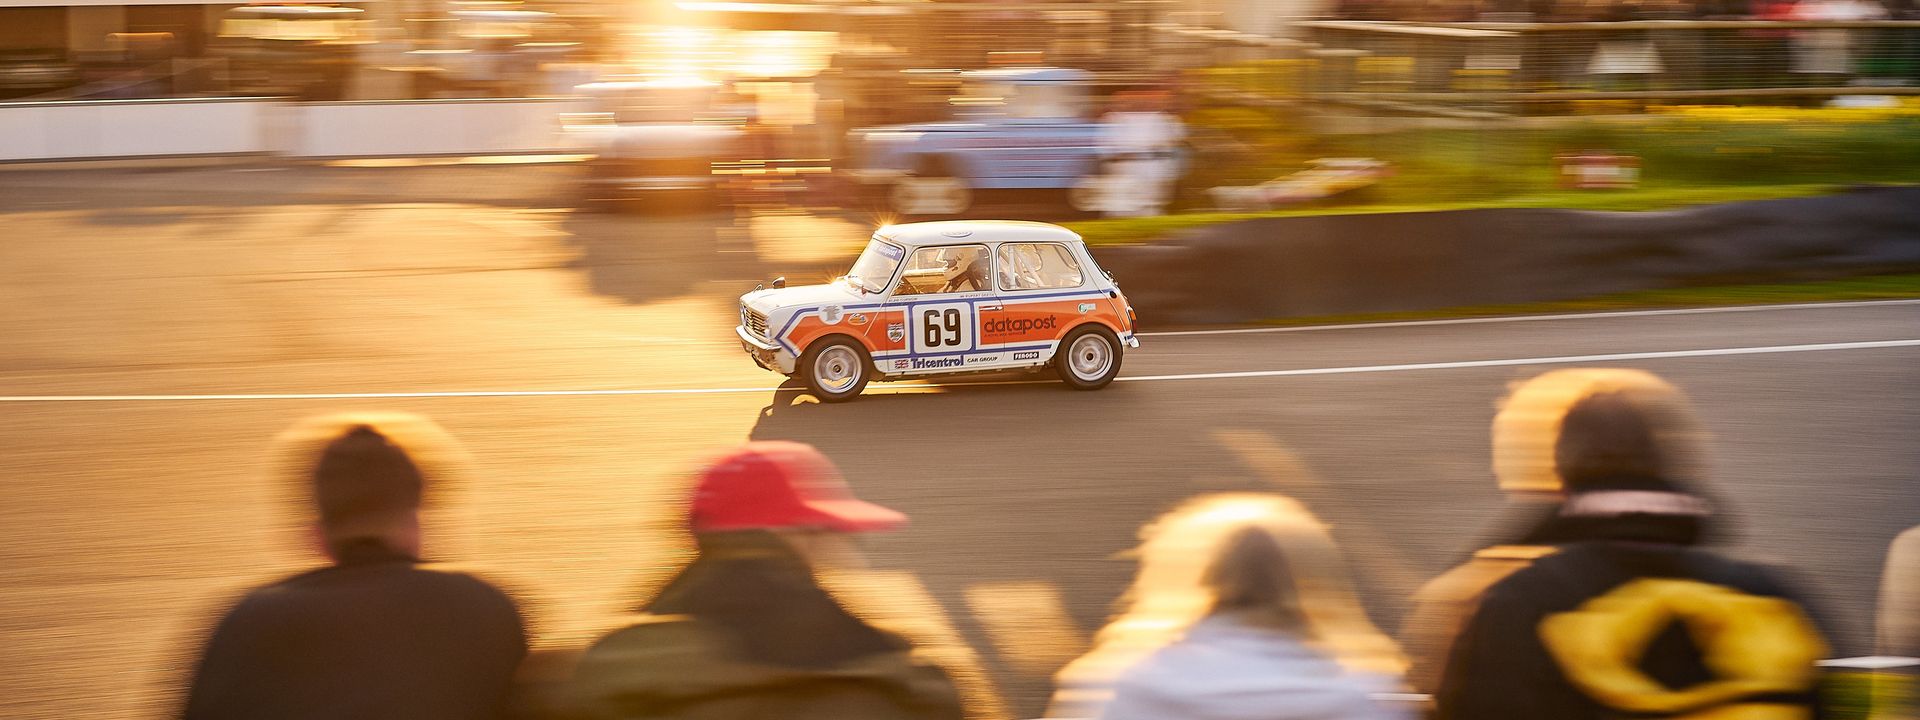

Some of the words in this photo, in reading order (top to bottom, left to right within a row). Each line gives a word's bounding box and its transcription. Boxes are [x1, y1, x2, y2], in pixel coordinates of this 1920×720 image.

[923, 308, 962, 348] 69
[984, 314, 1056, 335] datapost
[911, 355, 964, 369] Tricentrol
[1014, 352, 1038, 360] FERODO
